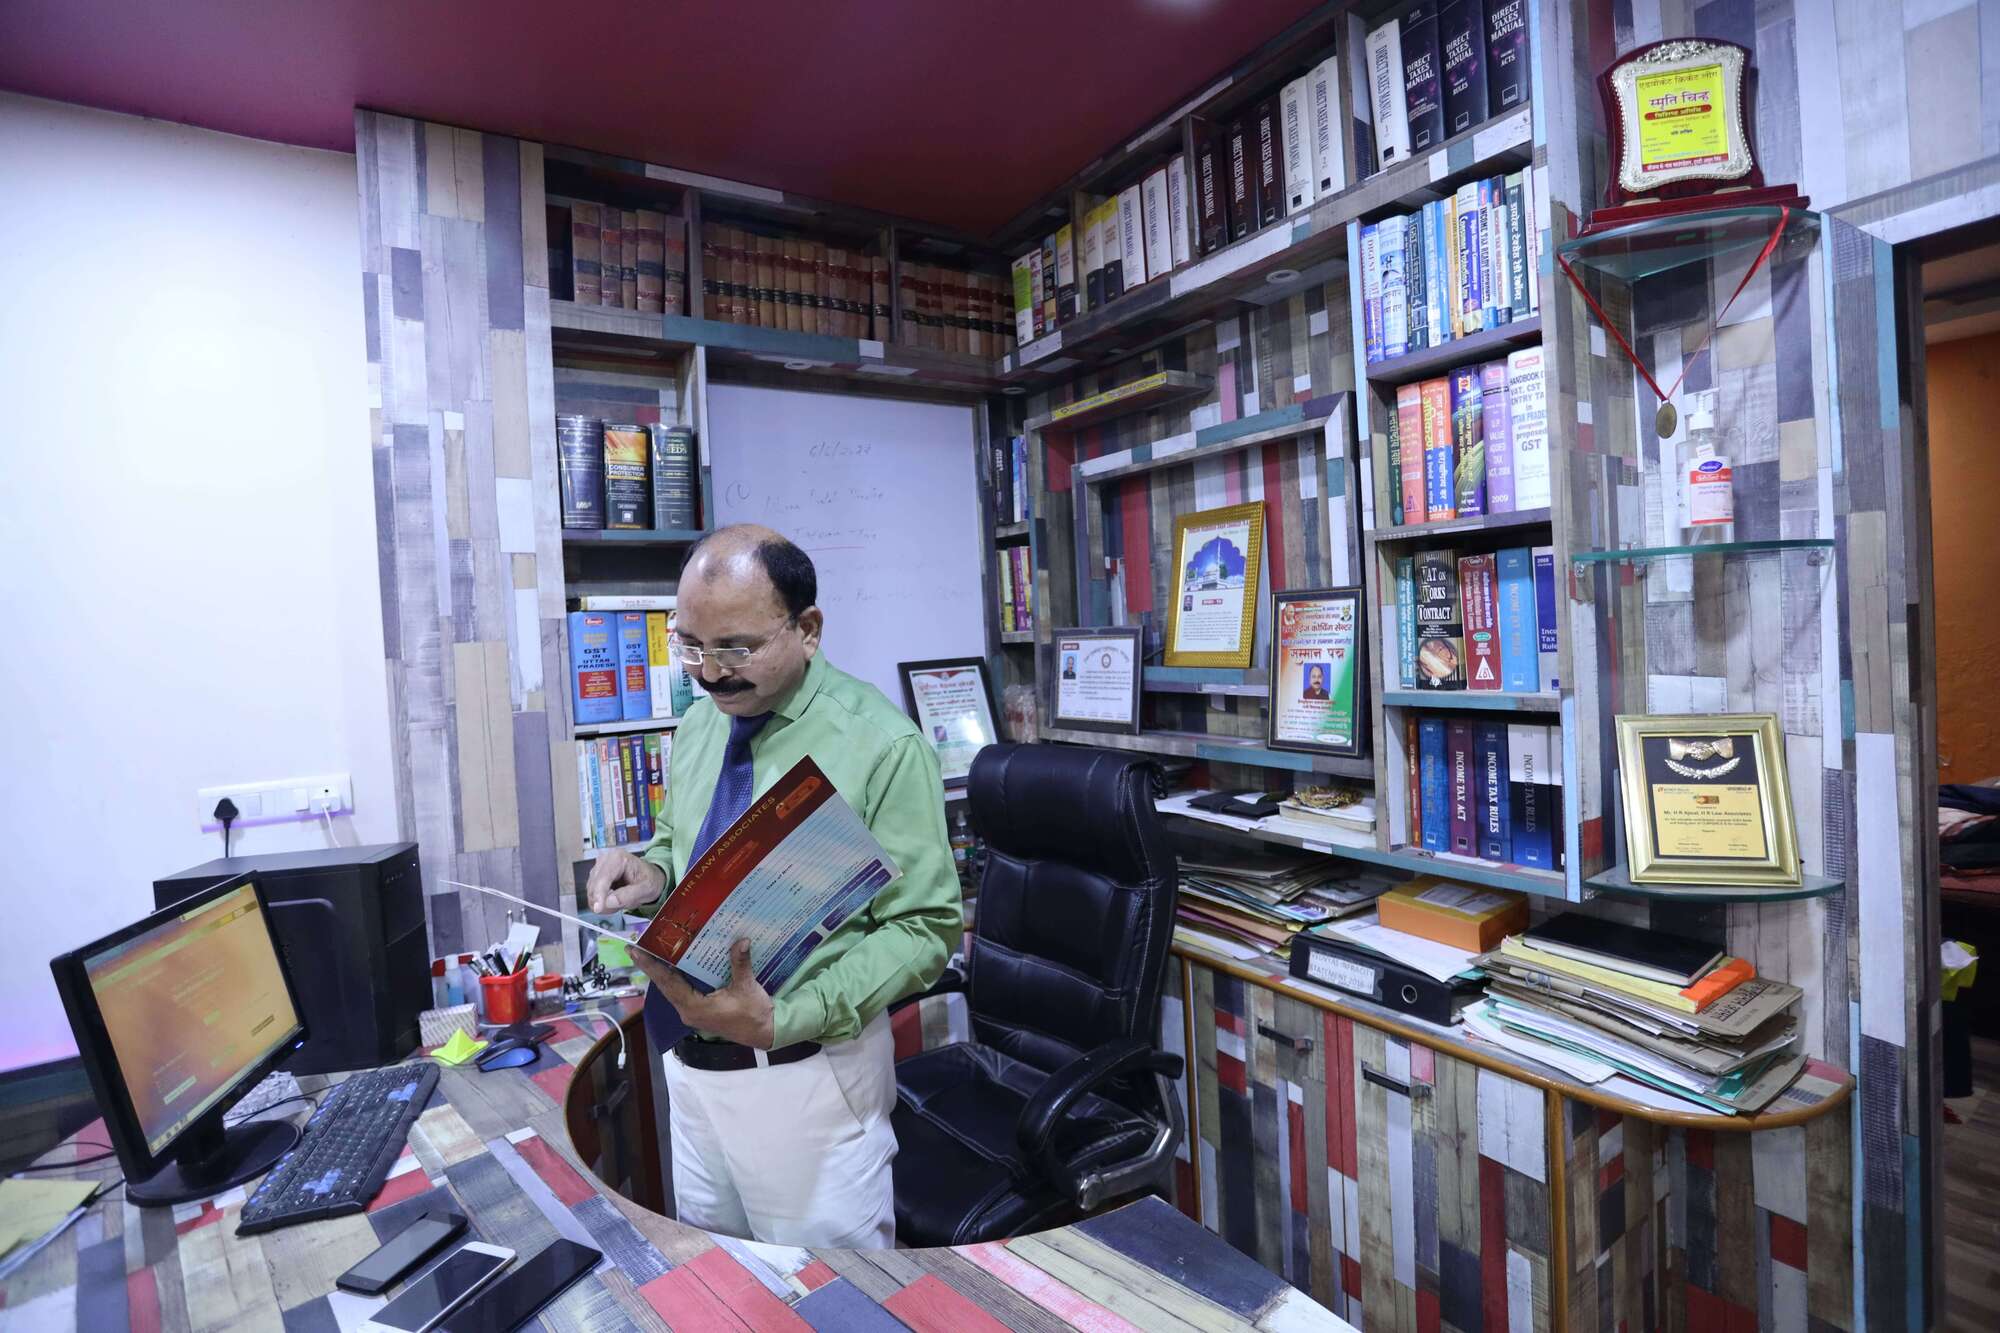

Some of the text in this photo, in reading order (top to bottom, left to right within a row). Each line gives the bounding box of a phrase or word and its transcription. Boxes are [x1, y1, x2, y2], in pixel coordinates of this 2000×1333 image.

[1491, 0, 1520, 24] DIRECT
[1494, 11, 1519, 32] TAXES
[1490, 18, 1525, 43] MANUAL
[1446, 31, 1470, 52] DIRECT
[1448, 41, 1469, 59] TAXES
[1407, 53, 1431, 74] DIRECT
[1408, 63, 1430, 79] TAXES
[1445, 50, 1474, 72] MANUAL
[1501, 54, 1516, 67] ACTS
[1376, 45, 1392, 123] DIRECT TAXES MANUAL
[1406, 70, 1435, 91] MANUAL
[1453, 82, 1468, 96] RULES
[1649, 90, 1710, 111] स्मृति चिन्ह
[1480, 206, 1489, 233] INCOME
[1367, 239, 1376, 272] DIGEST
[1510, 371, 1540, 385] HANDBOOK
[1527, 383, 1541, 391] CST
[1489, 431, 1505, 440] VALUE
[1521, 439, 1542, 452] GST
[1493, 456, 1503, 465] TAX
[1421, 566, 1446, 584] VAT ON
[1421, 585, 1446, 603] WORKS
[1417, 605, 1450, 620] CONTRACT
[1455, 751, 1467, 822] INCOME TAX ACT
[1487, 751, 1499, 833] INCOME TAX RULES
[1523, 754, 1536, 832] INCOME TAX RULES
[680, 796, 777, 897] HR LAW ASSOCIATES
